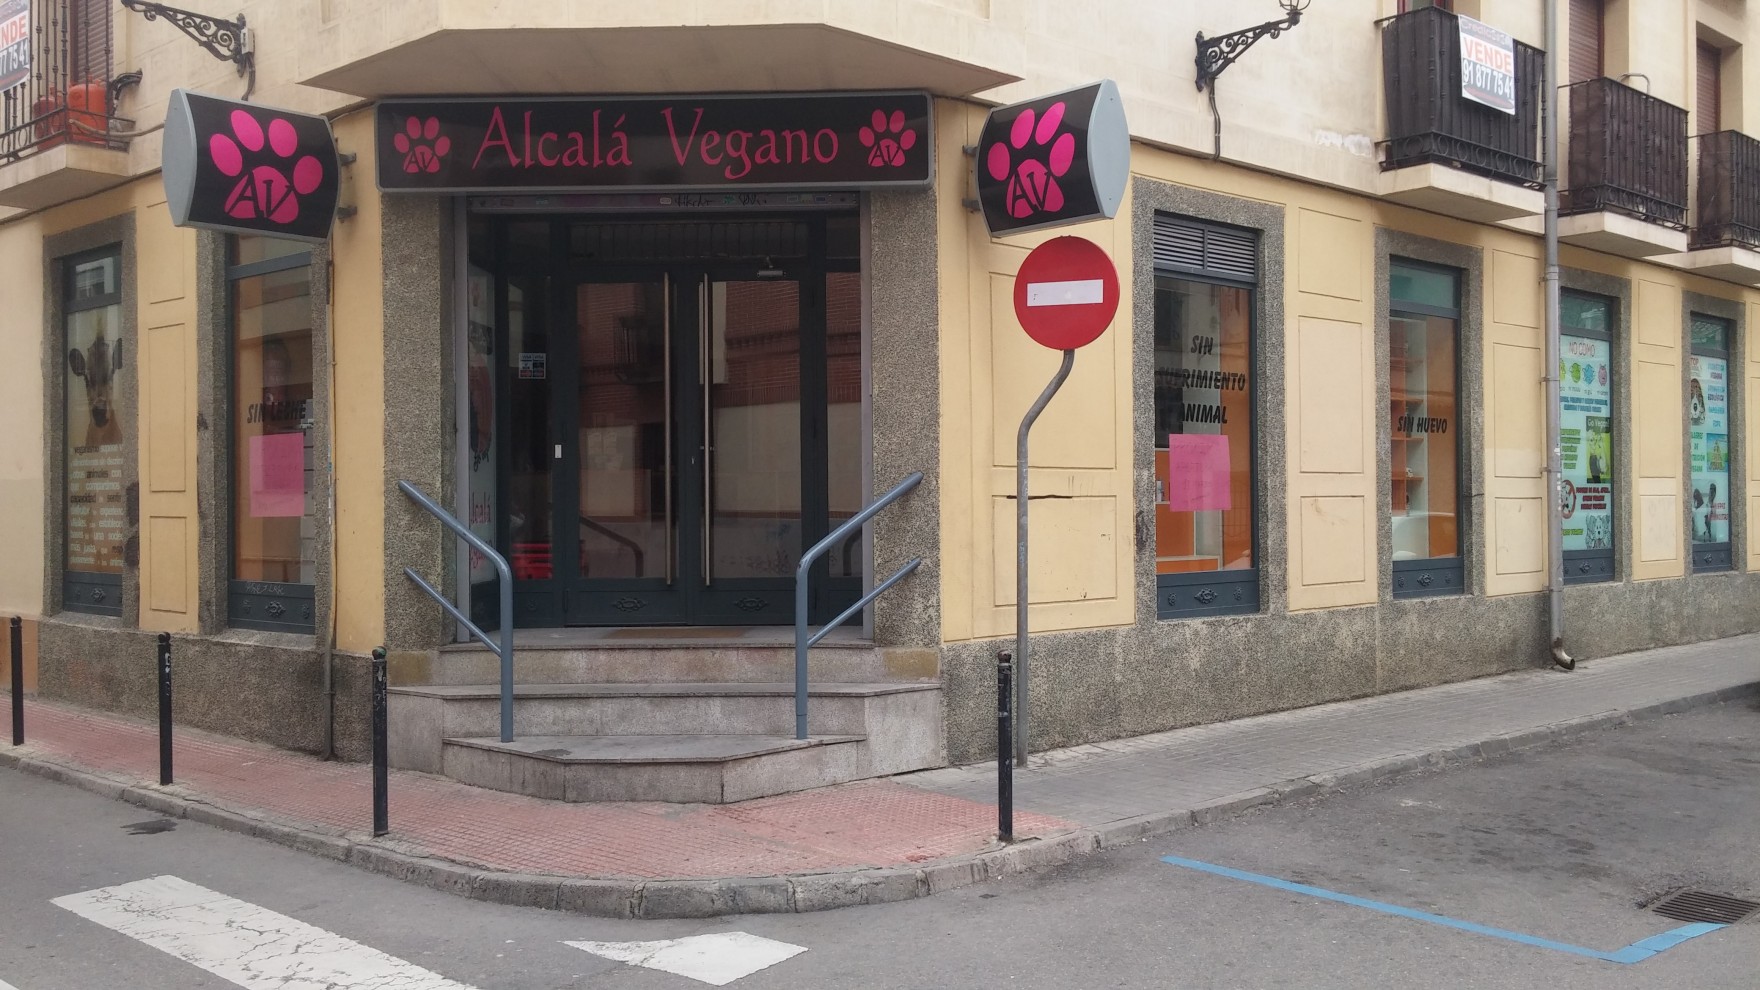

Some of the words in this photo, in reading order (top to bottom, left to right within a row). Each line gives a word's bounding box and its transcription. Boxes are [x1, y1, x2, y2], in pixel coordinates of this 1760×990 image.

[0, 15, 26, 50] NDE
[9, 44, 18, 71] 75
[19, 38, 28, 66] 41
[1463, 37, 1512, 75] VENDE
[1463, 60, 1474, 84] 91
[1475, 65, 1491, 90] 877
[471, 105, 633, 170] Alcalá
[660, 106, 839, 180] Vegano
[868, 143, 900, 168] AV
[403, 149, 436, 172] AV
[225, 170, 295, 219] AV
[1012, 170, 1051, 217] AV
[1190, 335, 1214, 356] SIN
[1579, 342, 1596, 357] COMO
[246, 402, 265, 424] SIN
[1397, 415, 1414, 433] SIN
[1416, 416, 1448, 434] HUEVO
